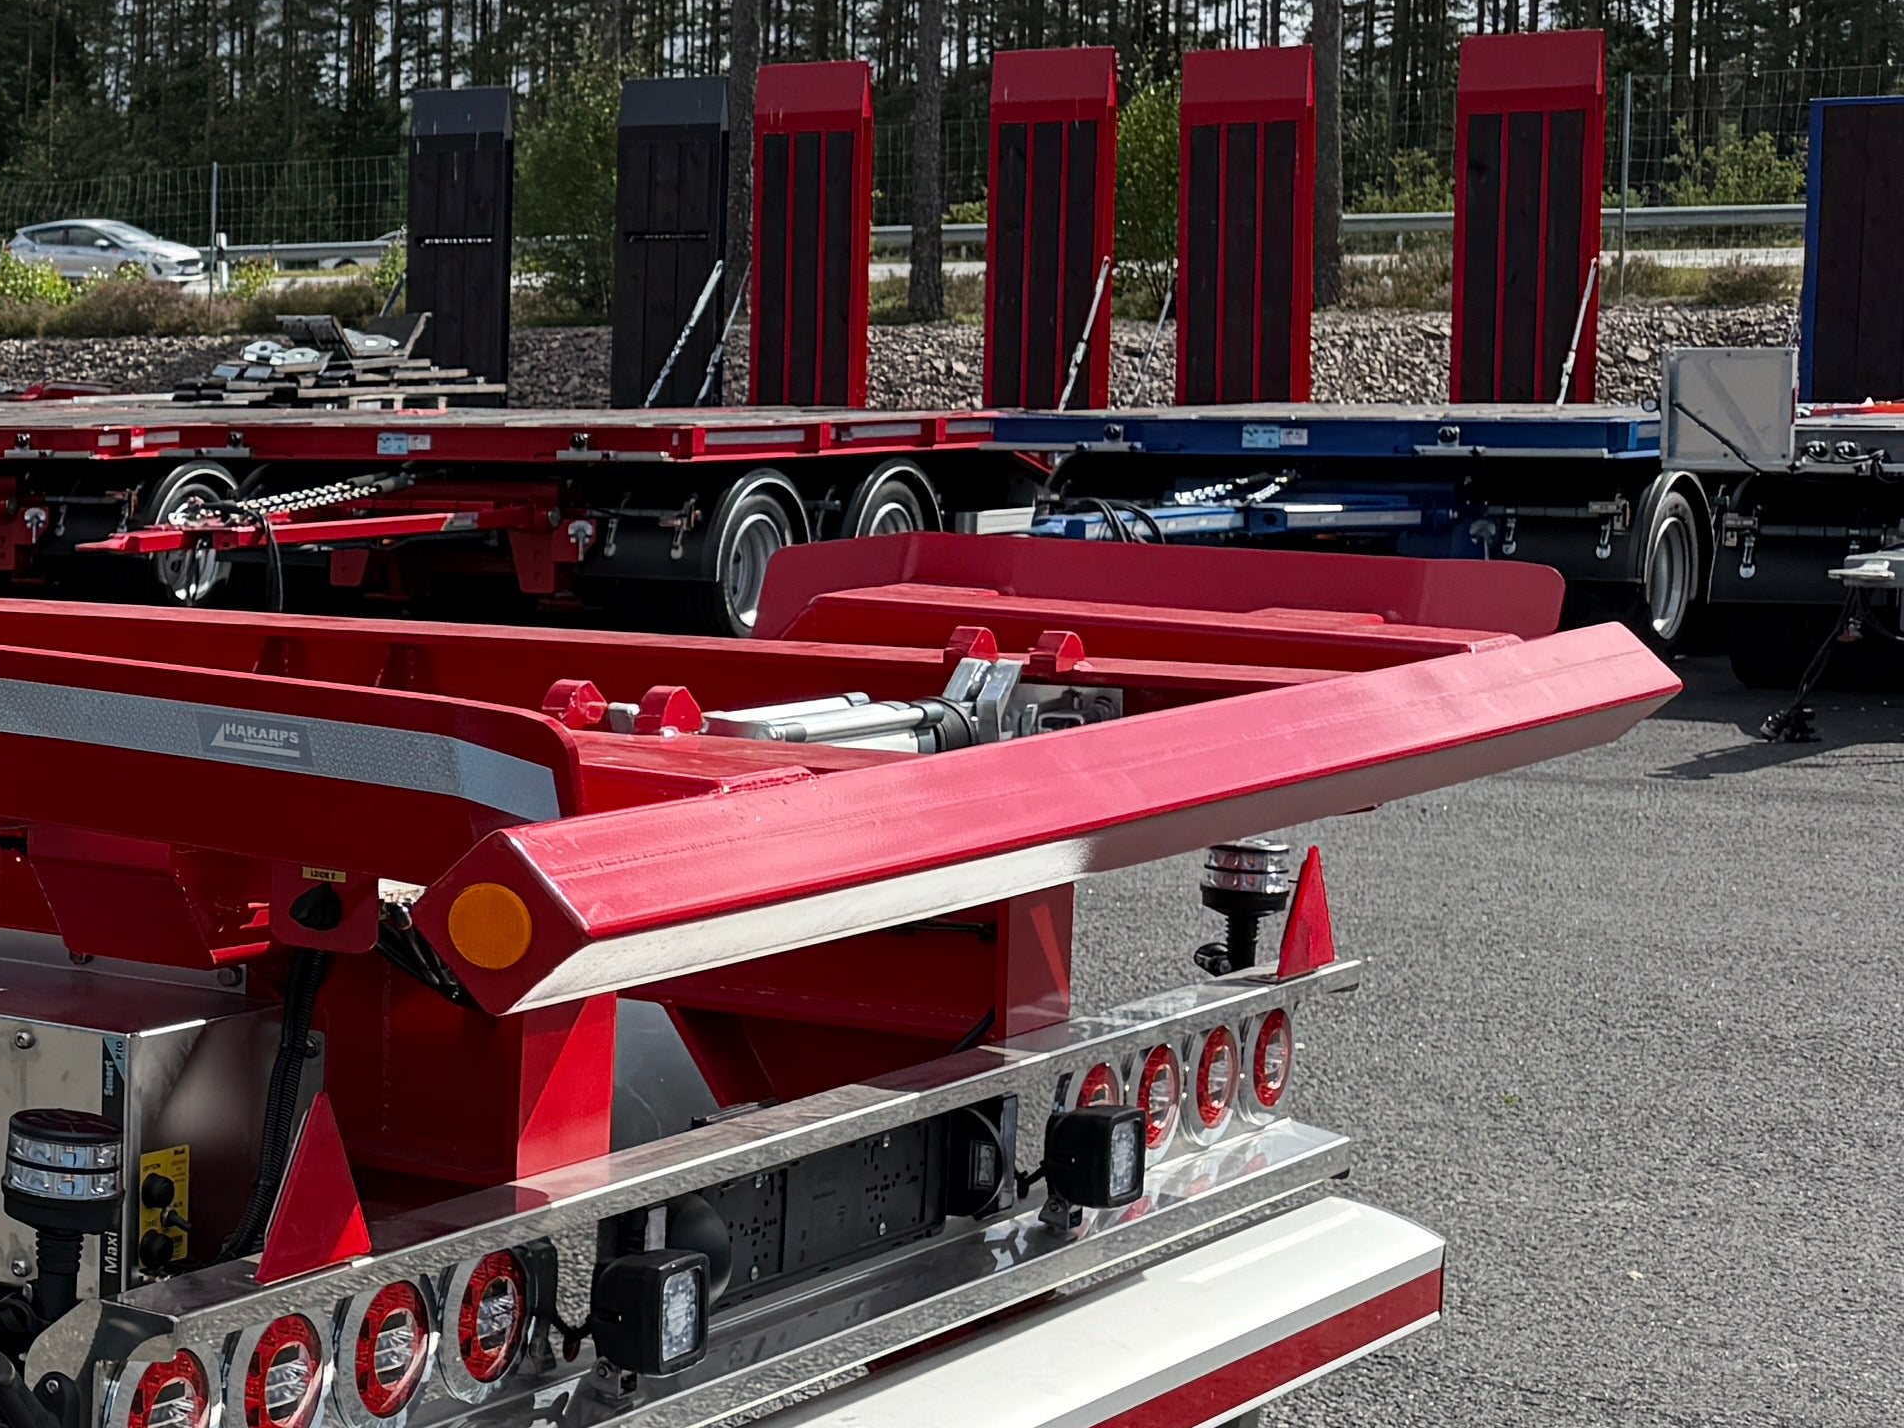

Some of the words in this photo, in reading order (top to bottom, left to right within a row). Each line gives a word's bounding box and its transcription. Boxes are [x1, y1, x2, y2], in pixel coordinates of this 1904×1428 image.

[224, 722, 299, 744] HAKARPS
[104, 1059, 115, 1097] Smart
[104, 1231, 119, 1275] Maxi
